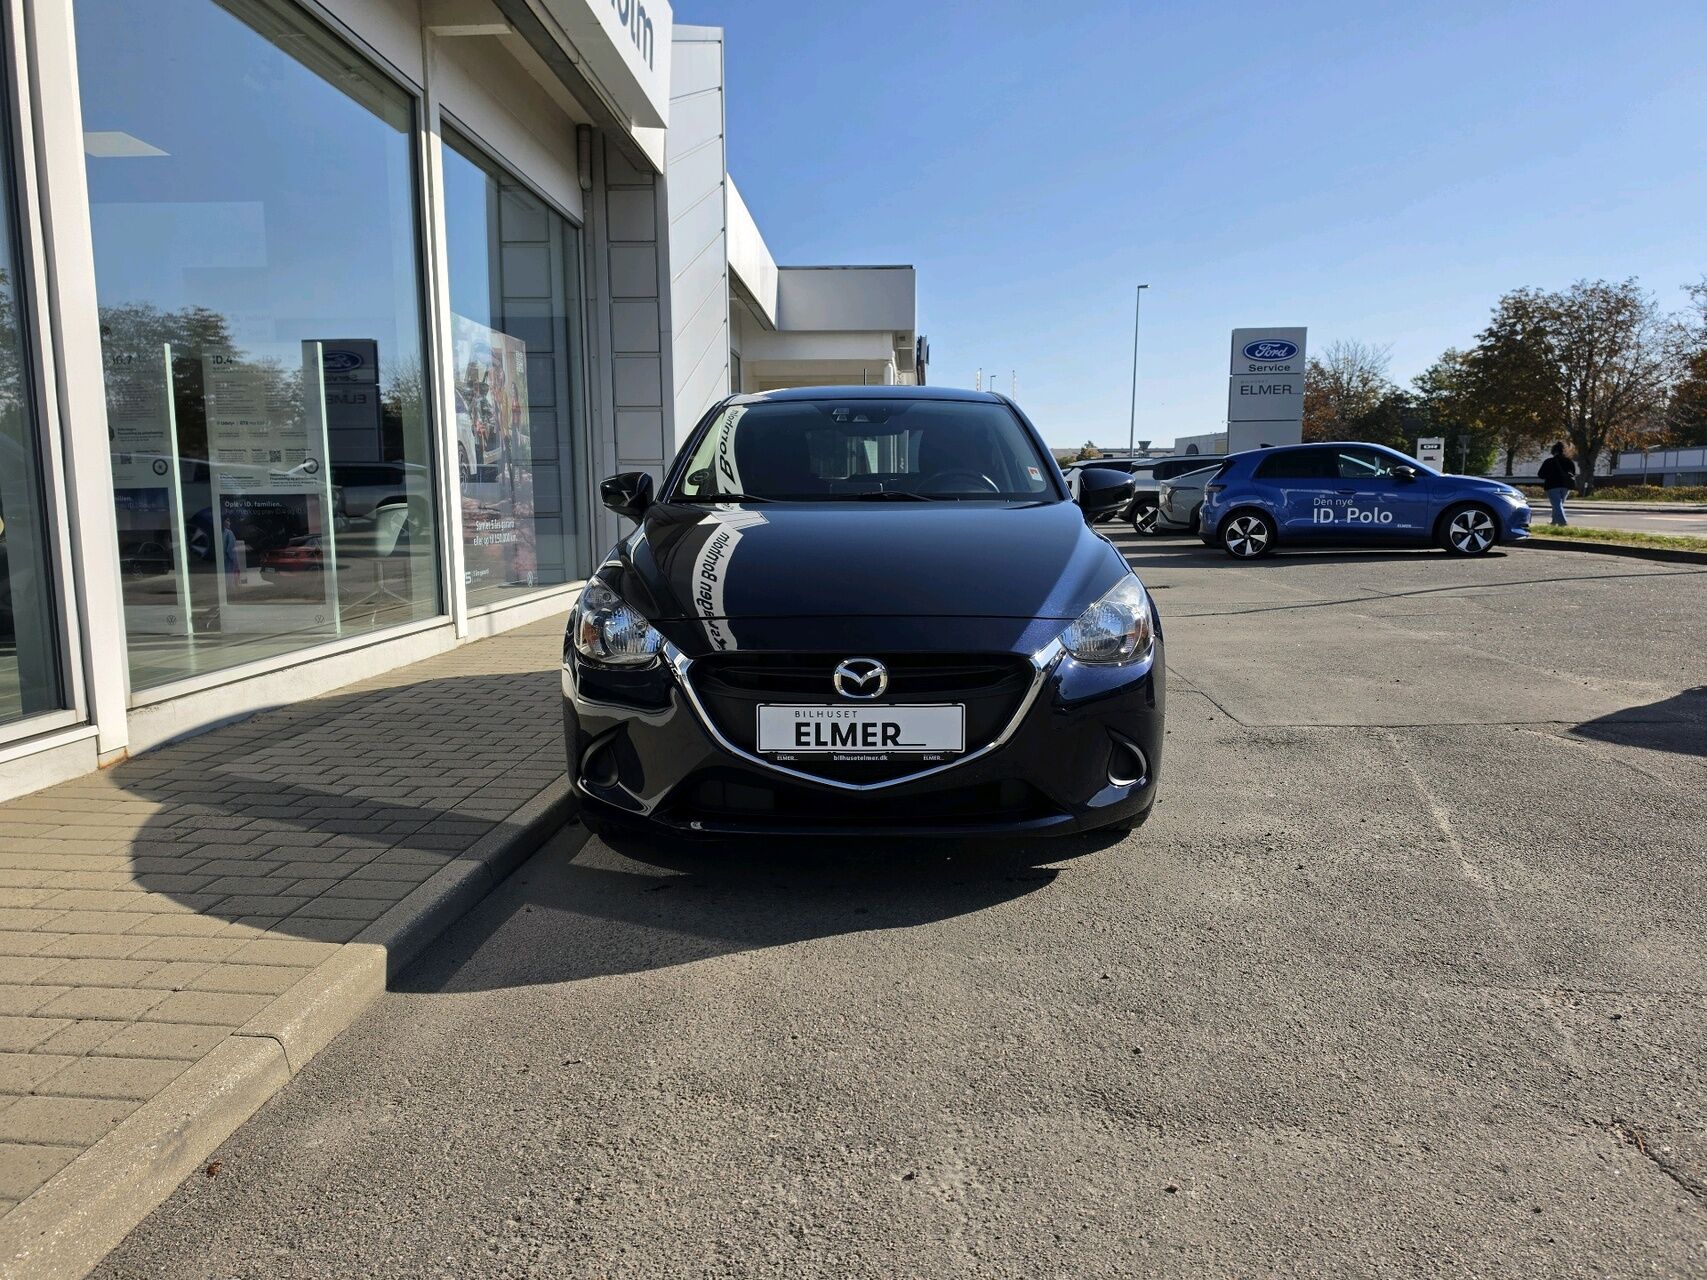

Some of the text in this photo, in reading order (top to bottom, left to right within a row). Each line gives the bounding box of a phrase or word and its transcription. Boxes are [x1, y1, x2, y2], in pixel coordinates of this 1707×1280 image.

[611, 0, 654, 72] olm
[1255, 344, 1288, 357] Ford
[1248, 364, 1290, 372] Service
[1240, 384, 1292, 395] ELMER
[1335, 498, 1354, 507] nye
[1313, 507, 1393, 523] ID. Polo
[794, 710, 858, 718] BILHUSET
[795, 722, 910, 748] ELMER
